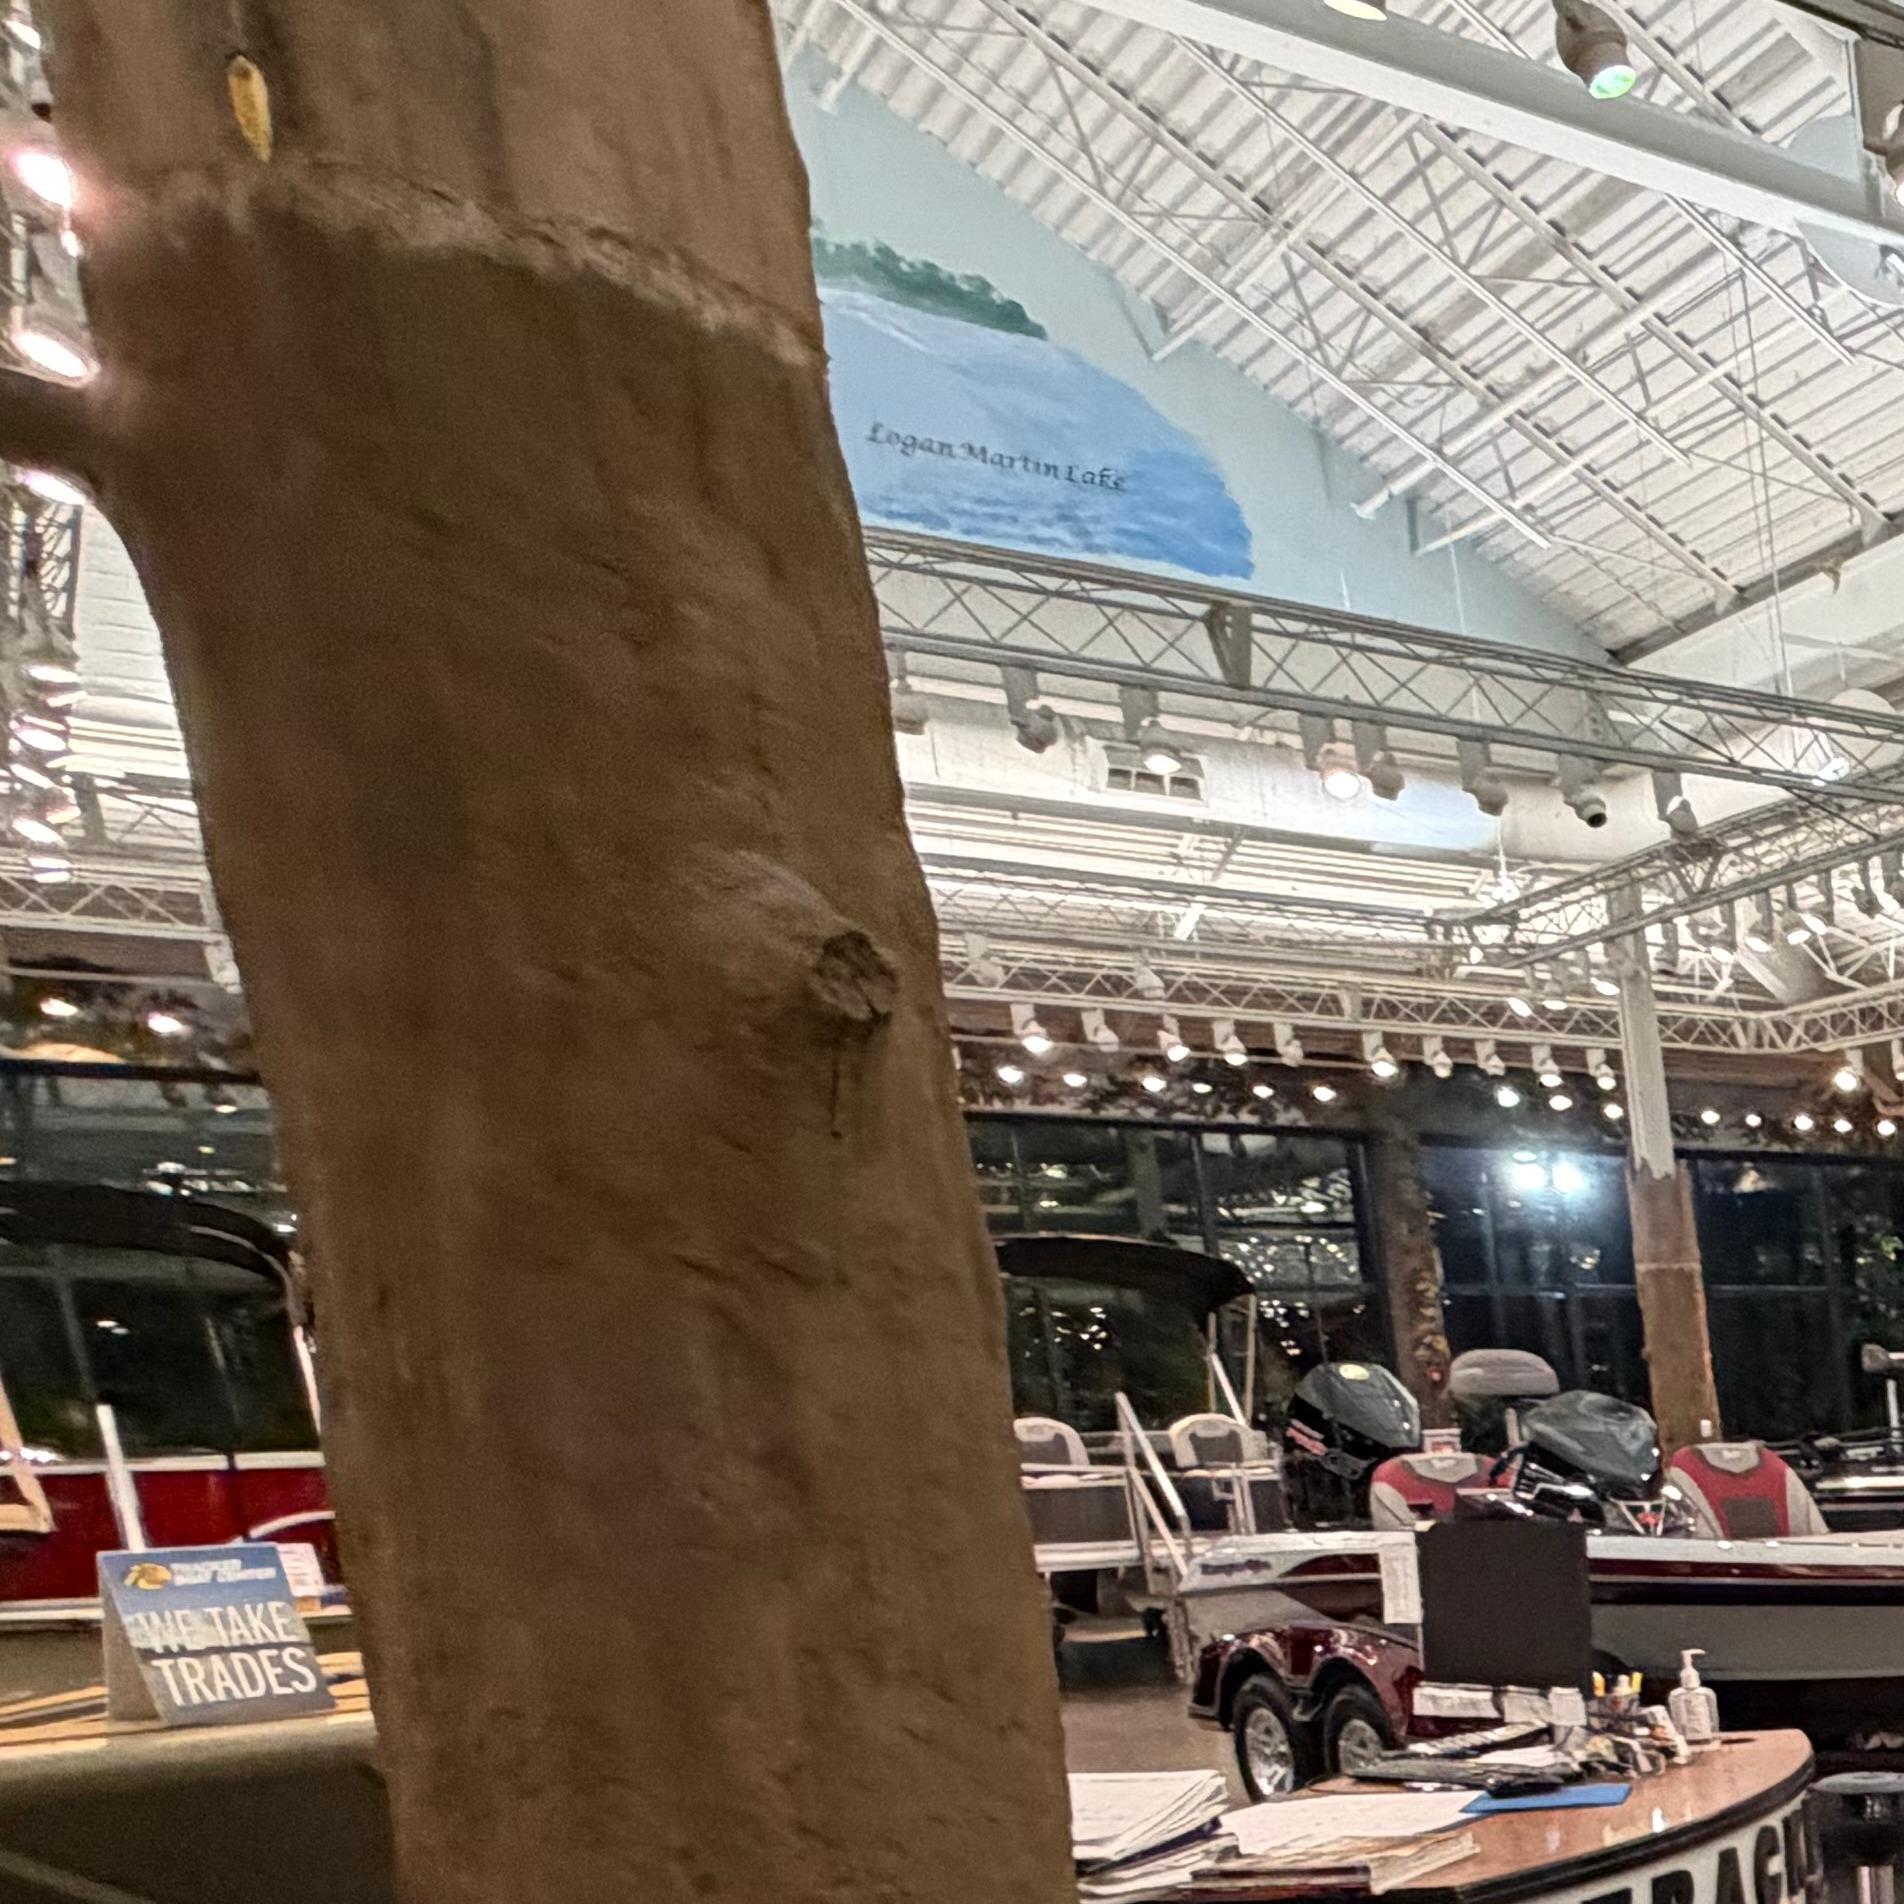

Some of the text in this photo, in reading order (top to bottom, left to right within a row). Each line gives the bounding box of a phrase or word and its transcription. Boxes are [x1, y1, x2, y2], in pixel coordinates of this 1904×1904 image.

[866, 422, 954, 458] Logan
[962, 440, 1060, 482] Martin
[136, 1600, 300, 1654] WE TAKE
[151, 1646, 318, 1707] TRADES
